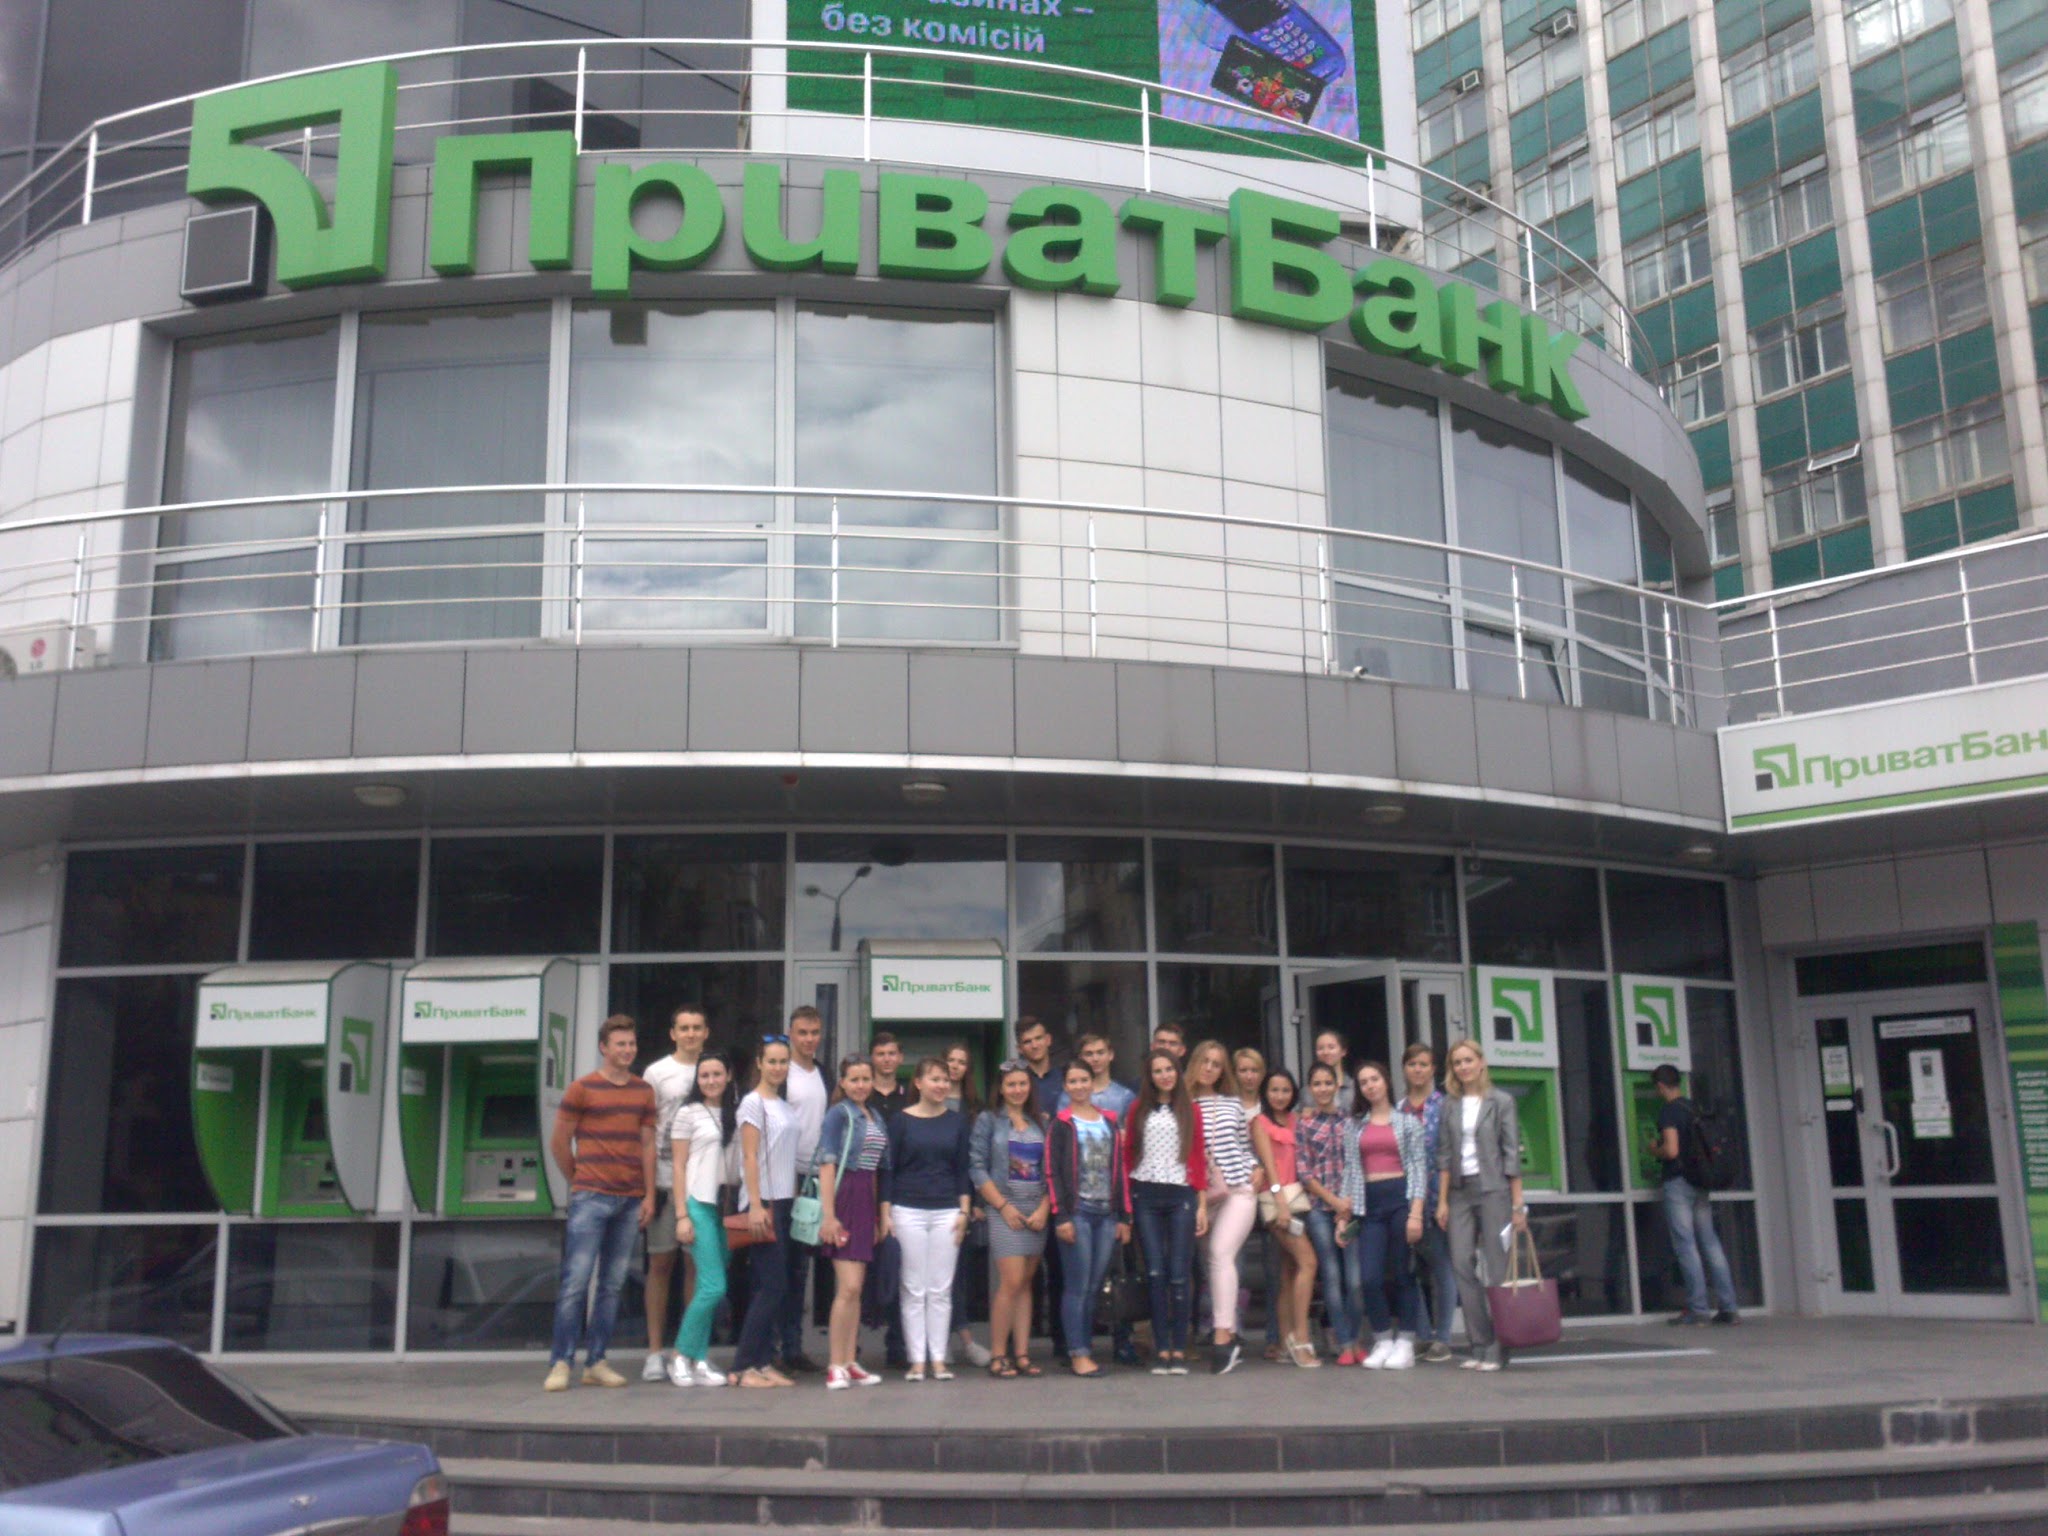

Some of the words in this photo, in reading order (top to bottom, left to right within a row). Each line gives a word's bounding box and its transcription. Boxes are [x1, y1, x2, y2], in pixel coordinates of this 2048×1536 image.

[820, 3, 892, 36] без
[903, 17, 1045, 53] комісій
[430, 130, 1590, 421] ПриватБанк
[900, 980, 991, 994] ПриватБанк
